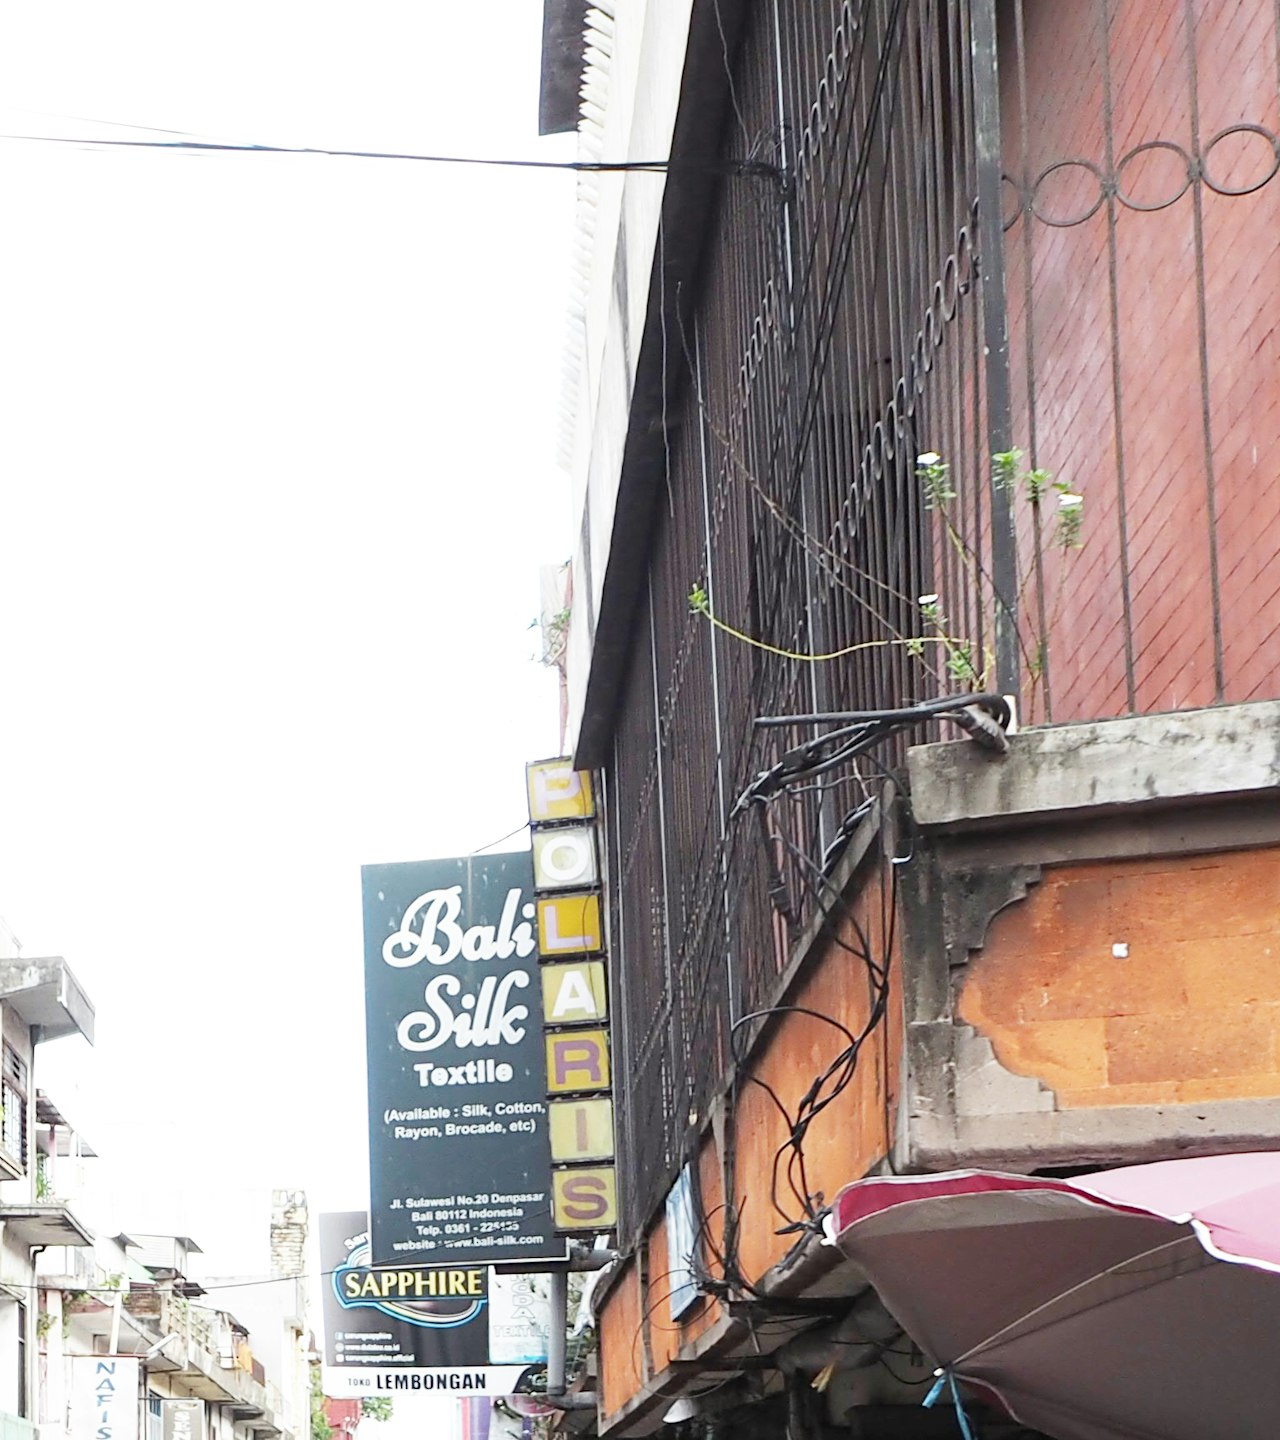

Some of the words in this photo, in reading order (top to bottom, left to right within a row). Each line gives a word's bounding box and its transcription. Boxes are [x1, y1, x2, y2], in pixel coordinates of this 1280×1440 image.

[382, 885, 536, 968] Bali
[532, 769, 610, 1221] POLARIS
[397, 970, 530, 1052] Silk
[413, 1059, 514, 1087] Textile
[384, 1106, 450, 1124] (Available
[462, 1105, 492, 1118] Silk,
[495, 1102, 546, 1115] Cotton,
[394, 1126, 442, 1140] Rayon,
[445, 1121, 506, 1136] Brocade,
[509, 1118, 537, 1133] etc)
[406, 1196, 455, 1208] Sulawesi
[491, 1192, 544, 1206] Denpasar
[411, 1210, 433, 1222] Bali
[469, 1206, 524, 1219] Indonesia
[416, 1225, 442, 1236] Telp.
[393, 1238, 436, 1251] website
[345, 1270, 483, 1297] SAPPHIRE
[348, 1378, 371, 1387] TOKO
[376, 1373, 486, 1390] LEMBONGAN
